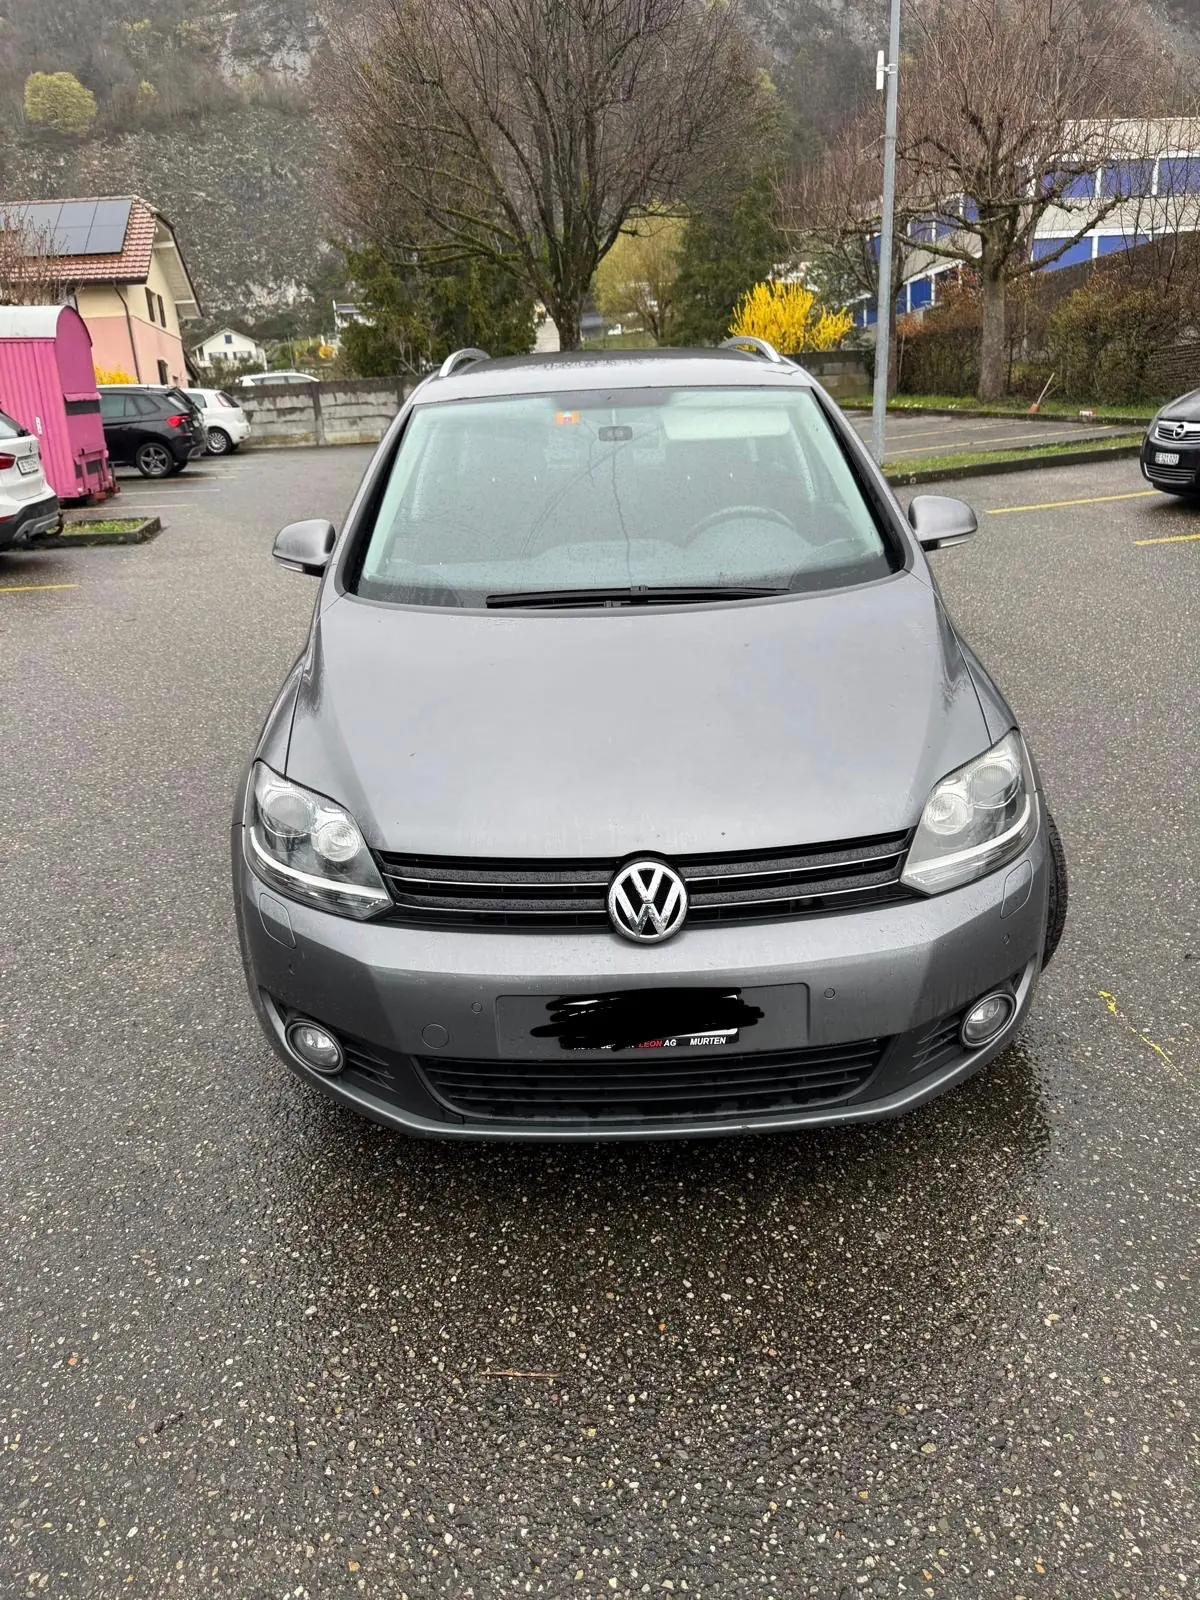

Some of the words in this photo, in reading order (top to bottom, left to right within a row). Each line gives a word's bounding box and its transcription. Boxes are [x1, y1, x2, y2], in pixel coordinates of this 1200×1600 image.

[611, 864, 684, 940] VW
[664, 1039, 677, 1047] AG
[690, 1037, 726, 1046] MURTEN
